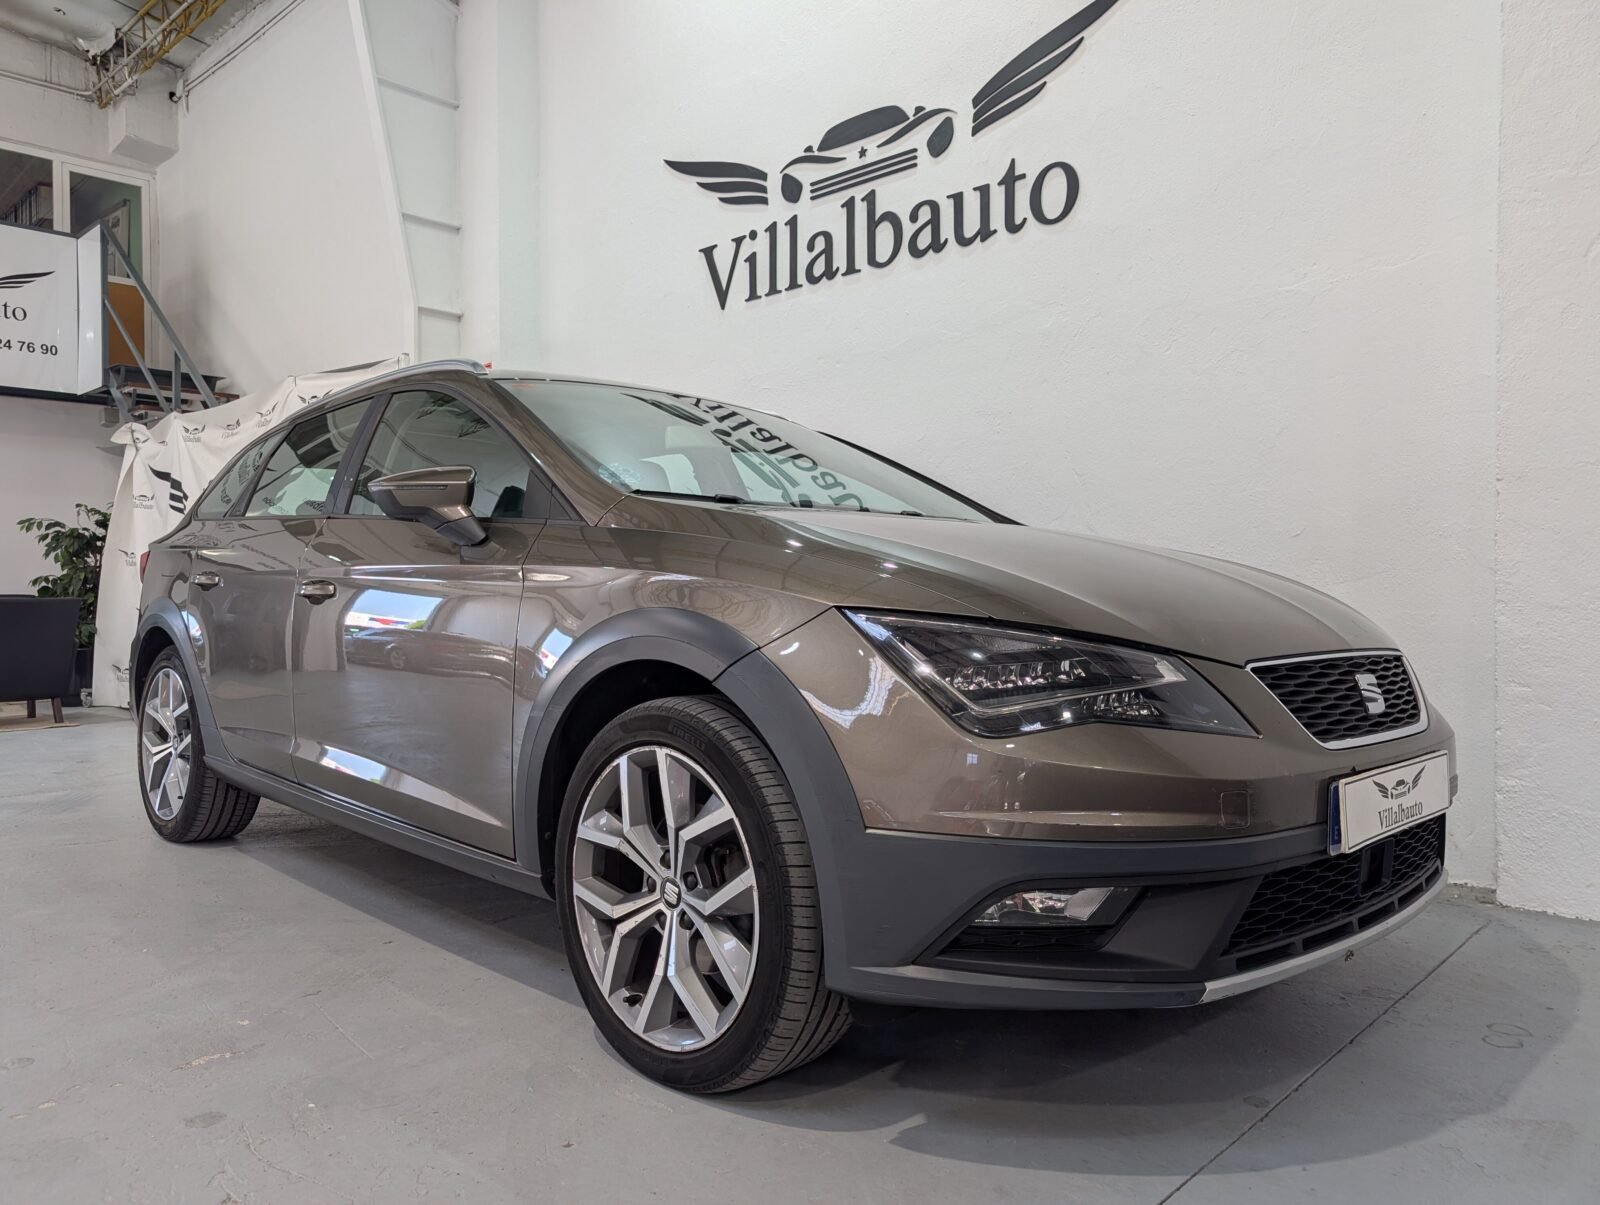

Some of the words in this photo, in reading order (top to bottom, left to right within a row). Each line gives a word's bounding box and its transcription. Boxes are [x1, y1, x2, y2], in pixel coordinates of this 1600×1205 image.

[699, 158, 1080, 311] Villalbauto
[0, 301, 28, 322] to
[0, 338, 13, 351] 4
[17, 340, 36, 353] 76
[40, 343, 58, 356] 90
[1378, 800, 1423, 830] Villalbauto
